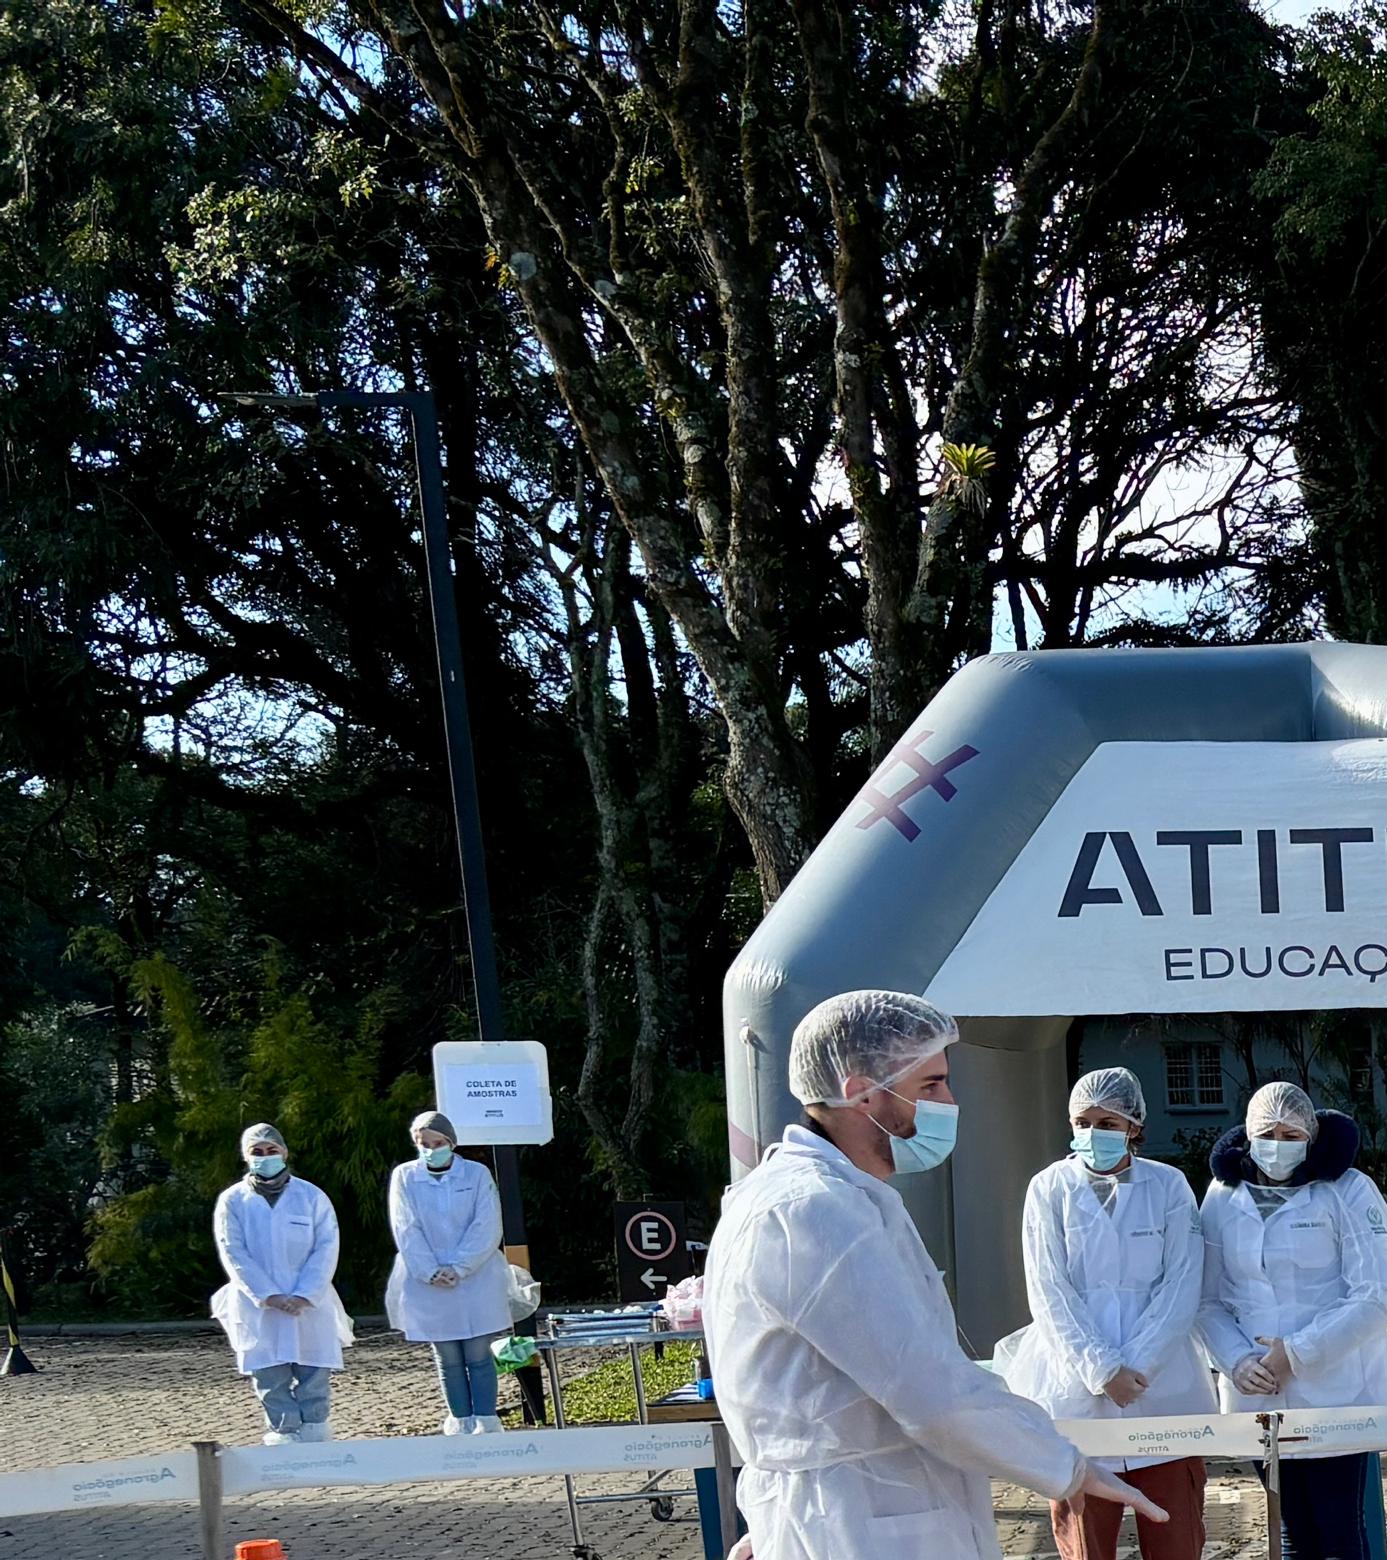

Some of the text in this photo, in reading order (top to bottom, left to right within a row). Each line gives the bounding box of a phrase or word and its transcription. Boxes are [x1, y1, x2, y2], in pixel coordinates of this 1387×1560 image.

[466, 1080, 517, 1088] COLETA DE
[467, 1090, 517, 1098] AMOSTRAS
[640, 1221, 662, 1250] E
